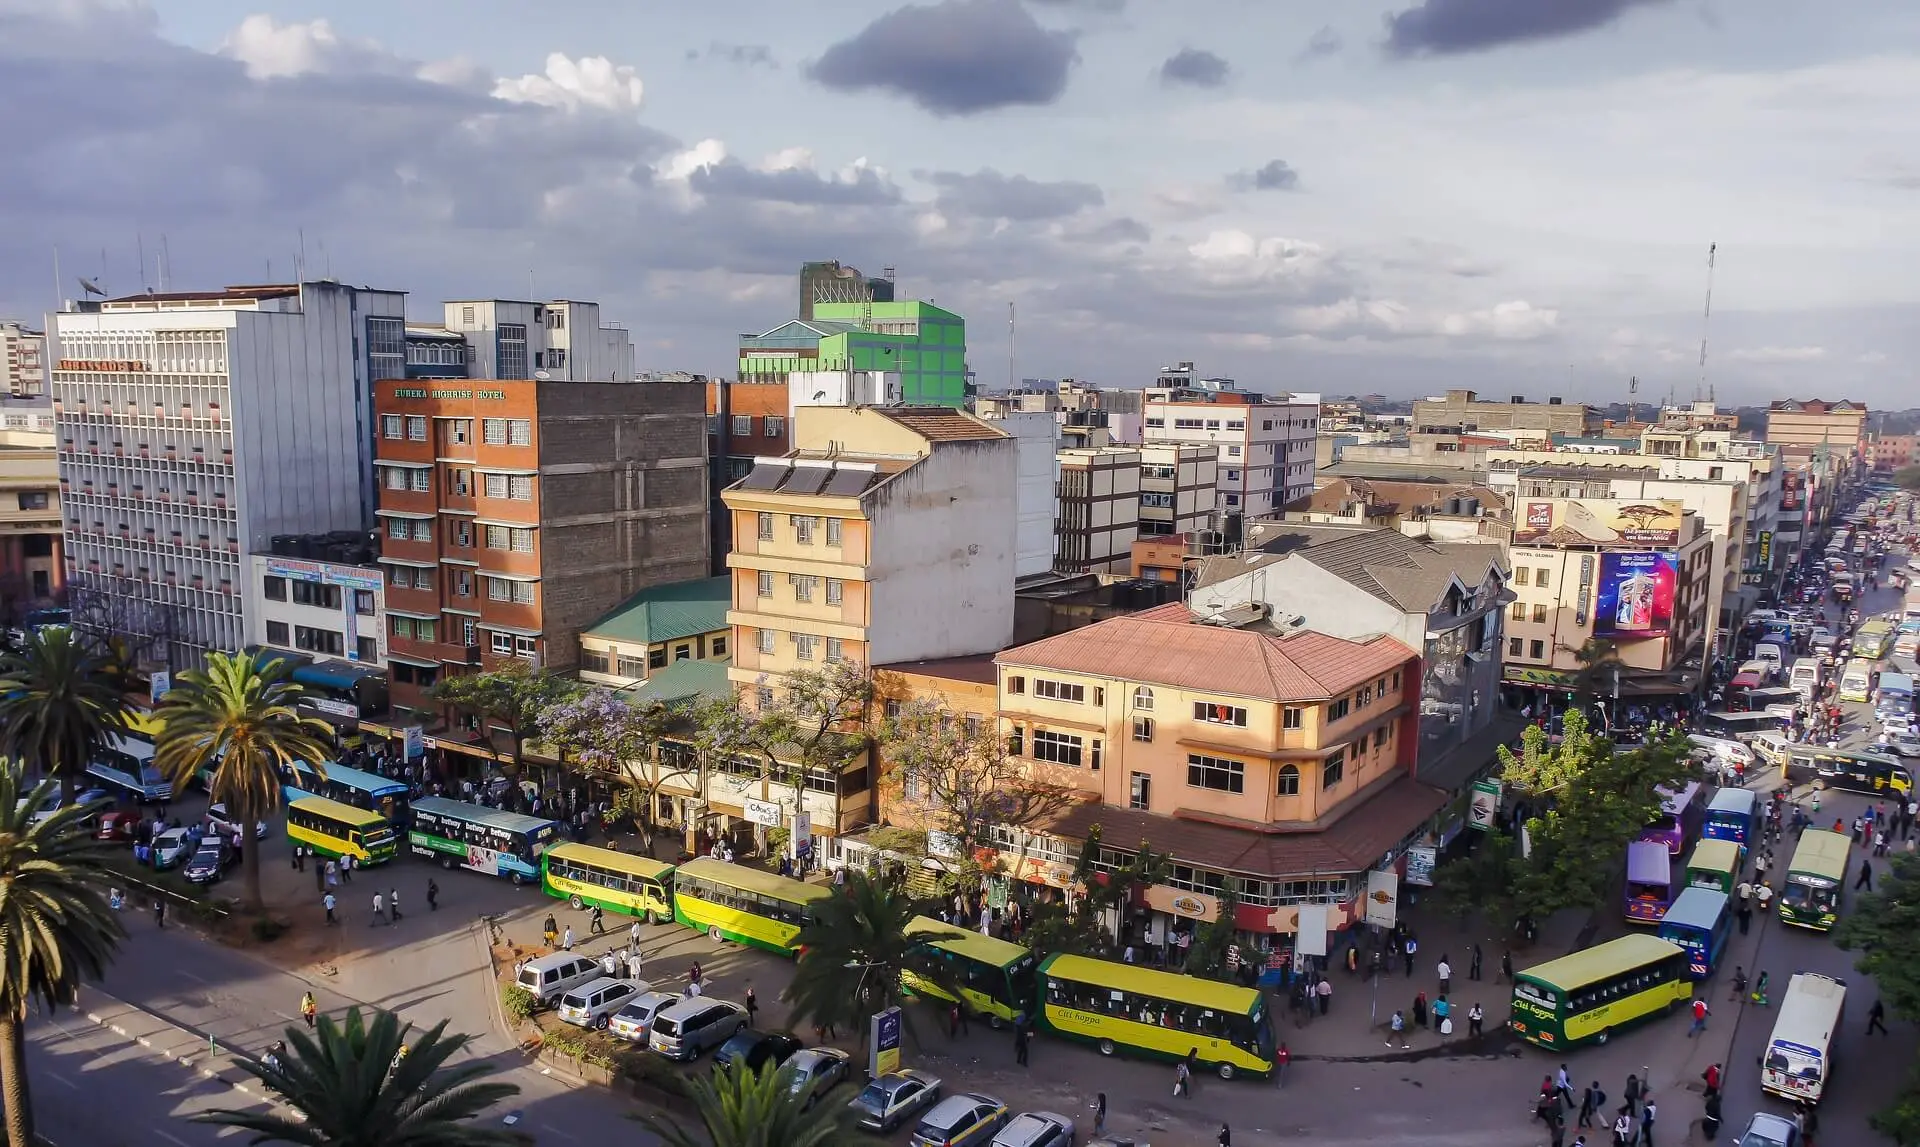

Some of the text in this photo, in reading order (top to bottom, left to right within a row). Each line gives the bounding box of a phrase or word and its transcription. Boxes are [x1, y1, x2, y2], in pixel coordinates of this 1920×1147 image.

[395, 389, 506, 399] EUREKA HIGHRISE HOTEL
[1528, 514, 1550, 524] Safari
[417, 811, 436, 823] betway
[441, 816, 461, 828] betway
[465, 822, 486, 835] betway
[490, 827, 512, 840] betway
[412, 844, 435, 858] betway
[1513, 1000, 1555, 1019] Citi hoppa
[1057, 1009, 1100, 1025] Citi hoppa
